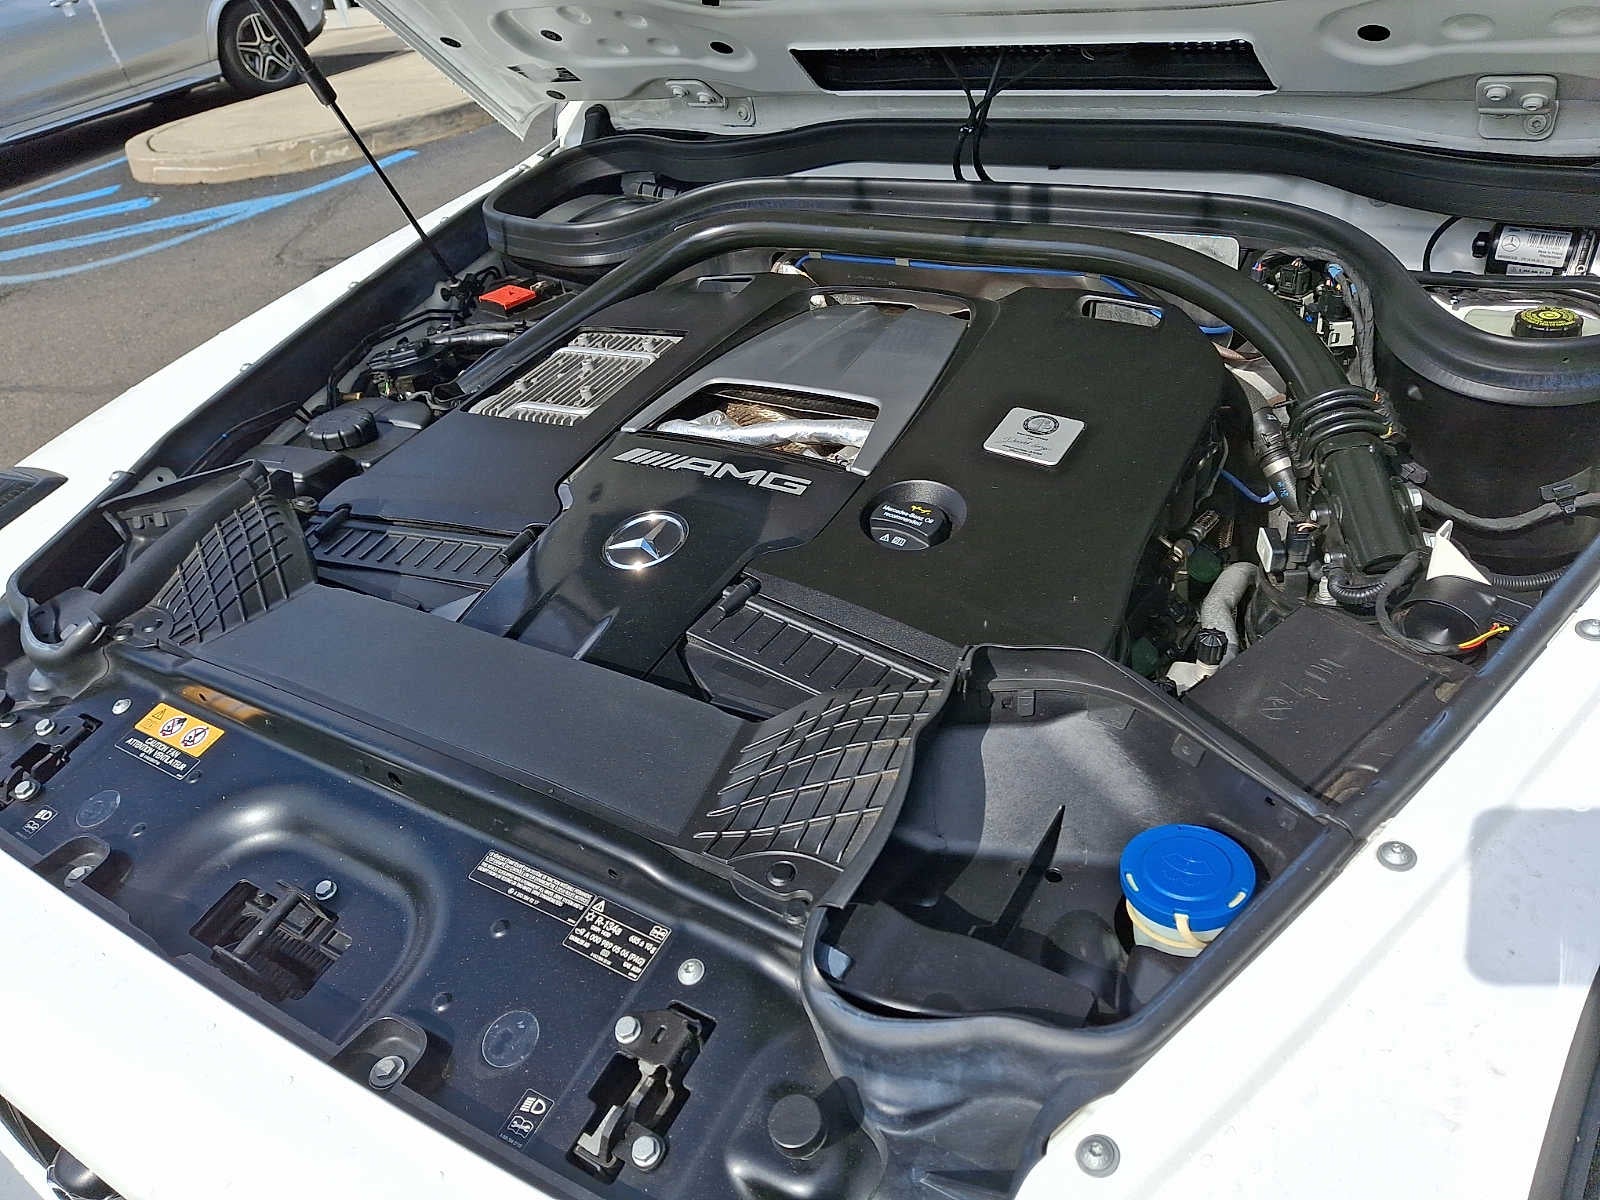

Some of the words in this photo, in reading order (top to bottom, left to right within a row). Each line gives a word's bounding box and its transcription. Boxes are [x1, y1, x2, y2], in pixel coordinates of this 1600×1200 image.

[675, 456, 813, 496] AMG
[882, 504, 924, 521] Mercedes-Benz
[883, 511, 923, 526] recommended
[125, 737, 155, 755] ATTENTION
[152, 750, 187, 770] VENTILATEUR
[145, 737, 170, 753] CAUTION
[165, 747, 181, 759] FAN
[594, 915, 623, 936] R-134a
[589, 933, 602, 944] 000
[601, 939, 614, 950] 989
